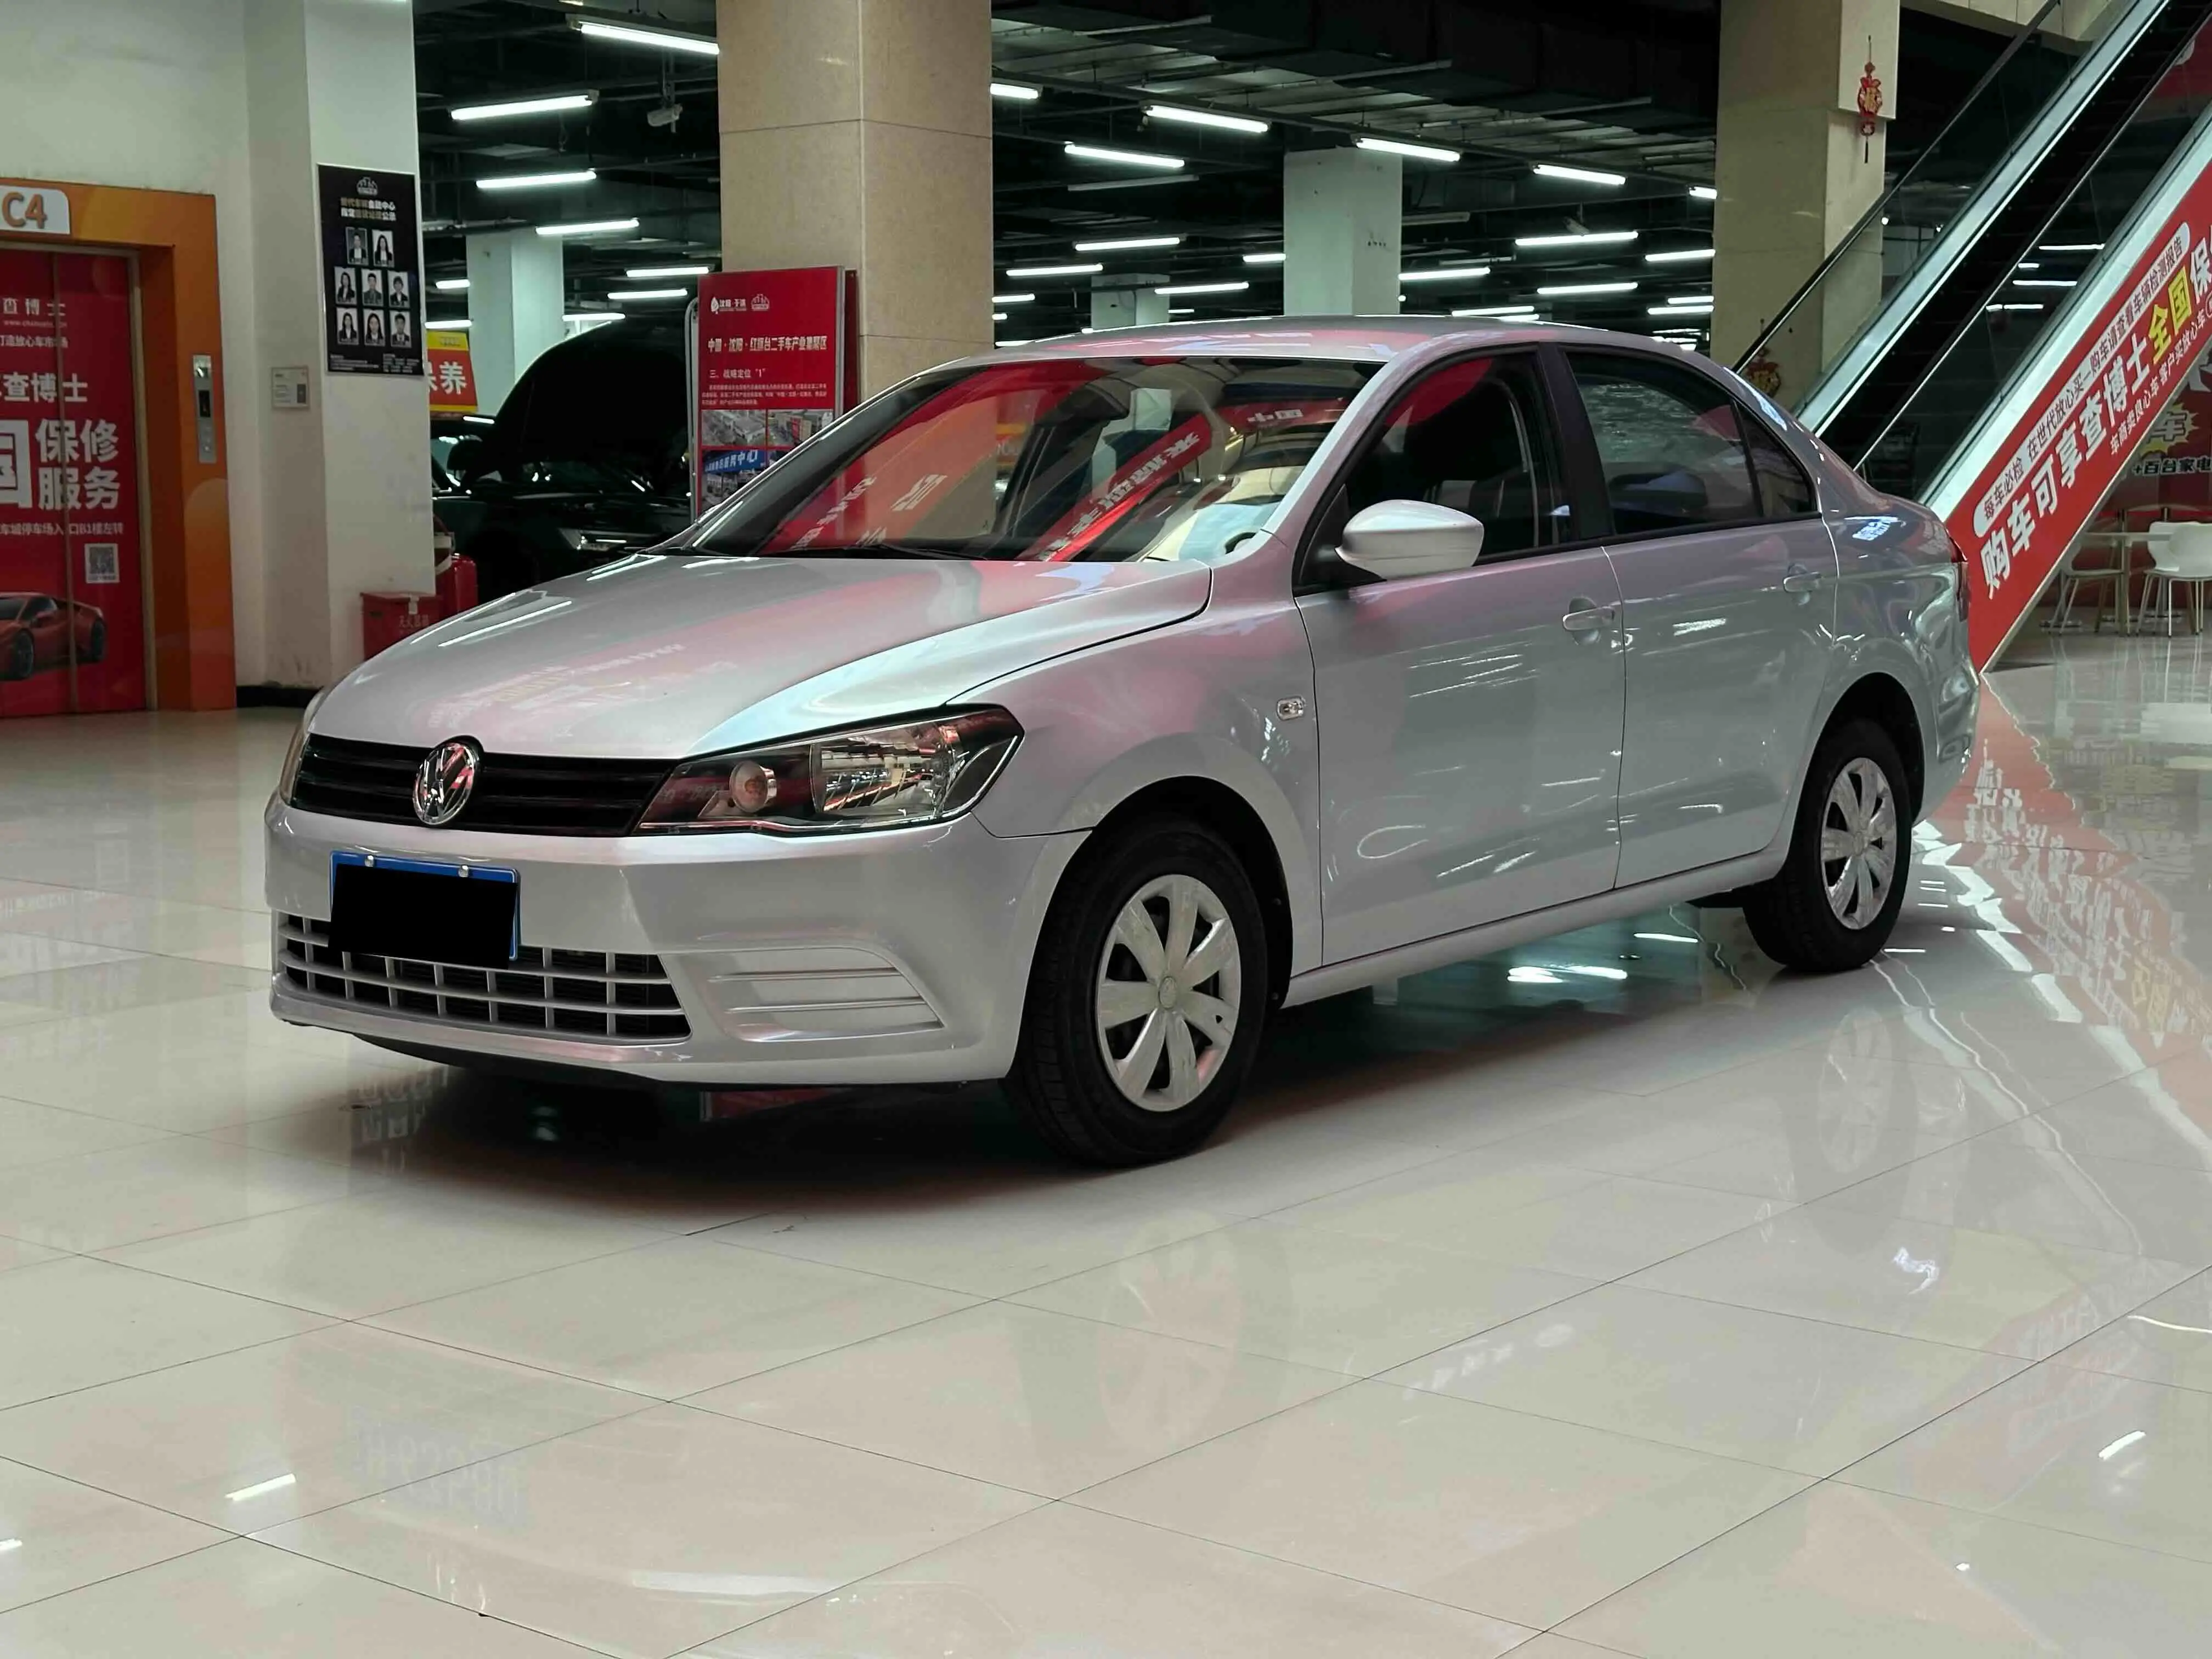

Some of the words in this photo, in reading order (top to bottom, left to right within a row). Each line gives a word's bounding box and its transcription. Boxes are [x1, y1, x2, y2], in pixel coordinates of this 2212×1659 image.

[2, 191, 48, 229] C4
[0, 371, 88, 403] 查博士
[1980, 225, 2212, 600] 购车可享查博士全国保
[36, 419, 119, 463] 保修
[38, 466, 121, 511] 服务
